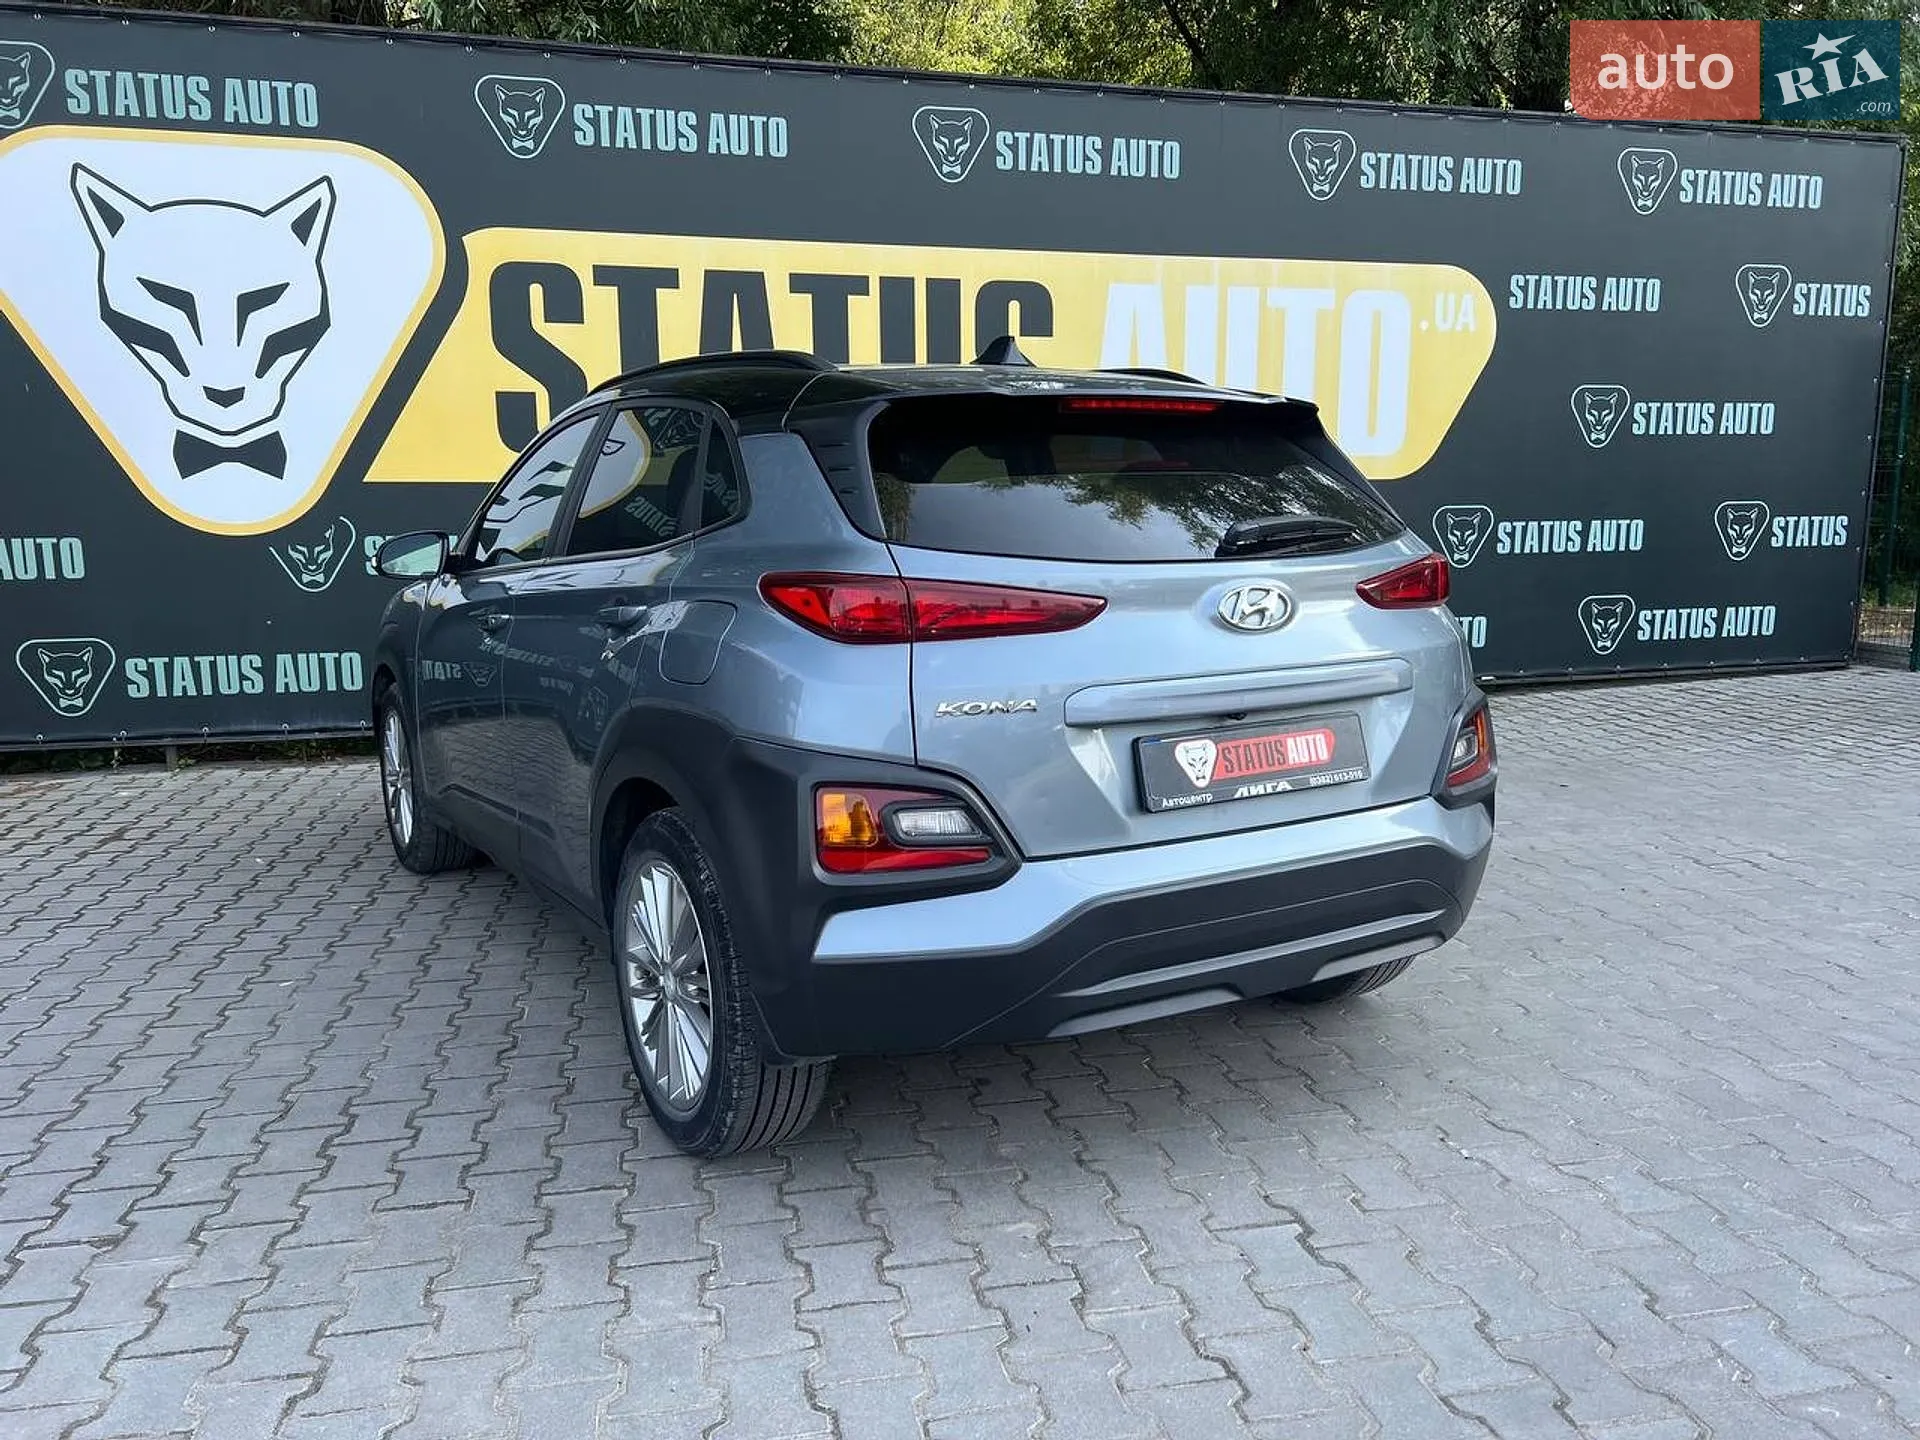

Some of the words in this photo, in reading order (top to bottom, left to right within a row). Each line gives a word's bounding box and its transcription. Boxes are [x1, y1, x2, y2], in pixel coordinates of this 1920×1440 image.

[65, 69, 212, 121] STATUS
[224, 78, 319, 128] AUTO
[573, 103, 698, 153] STATUS
[708, 113, 788, 158] AUTO
[995, 130, 1103, 175] STATUS
[1110, 137, 1180, 179] AUTO
[1360, 151, 1454, 192] STATUS
[1460, 157, 1522, 195] AUTO
[1679, 168, 1763, 207] STATUS
[1767, 173, 1824, 209] AUTO
[1508, 274, 1598, 311] STATUS
[1602, 277, 1661, 312] AUTO
[1792, 282, 1872, 317] STATUS
[1632, 402, 1716, 435] STATUS
[1719, 402, 1775, 435] AUTO
[1496, 520, 1583, 555] STATUS
[1587, 519, 1644, 552] AUTO
[1770, 515, 1849, 548] STATUS
[0, 537, 85, 581] AUTO
[1455, 616, 1488, 648] TO
[1637, 607, 1718, 641] STATUS
[1722, 605, 1776, 638] AUTO
[124, 654, 265, 698] STATUS
[275, 651, 364, 694] AUTO
[935, 699, 1038, 718] KONA
[1222, 738, 1286, 774] STATUS
[1286, 732, 1328, 765] AUTO
[1233, 780, 1294, 799] ЛИГА
